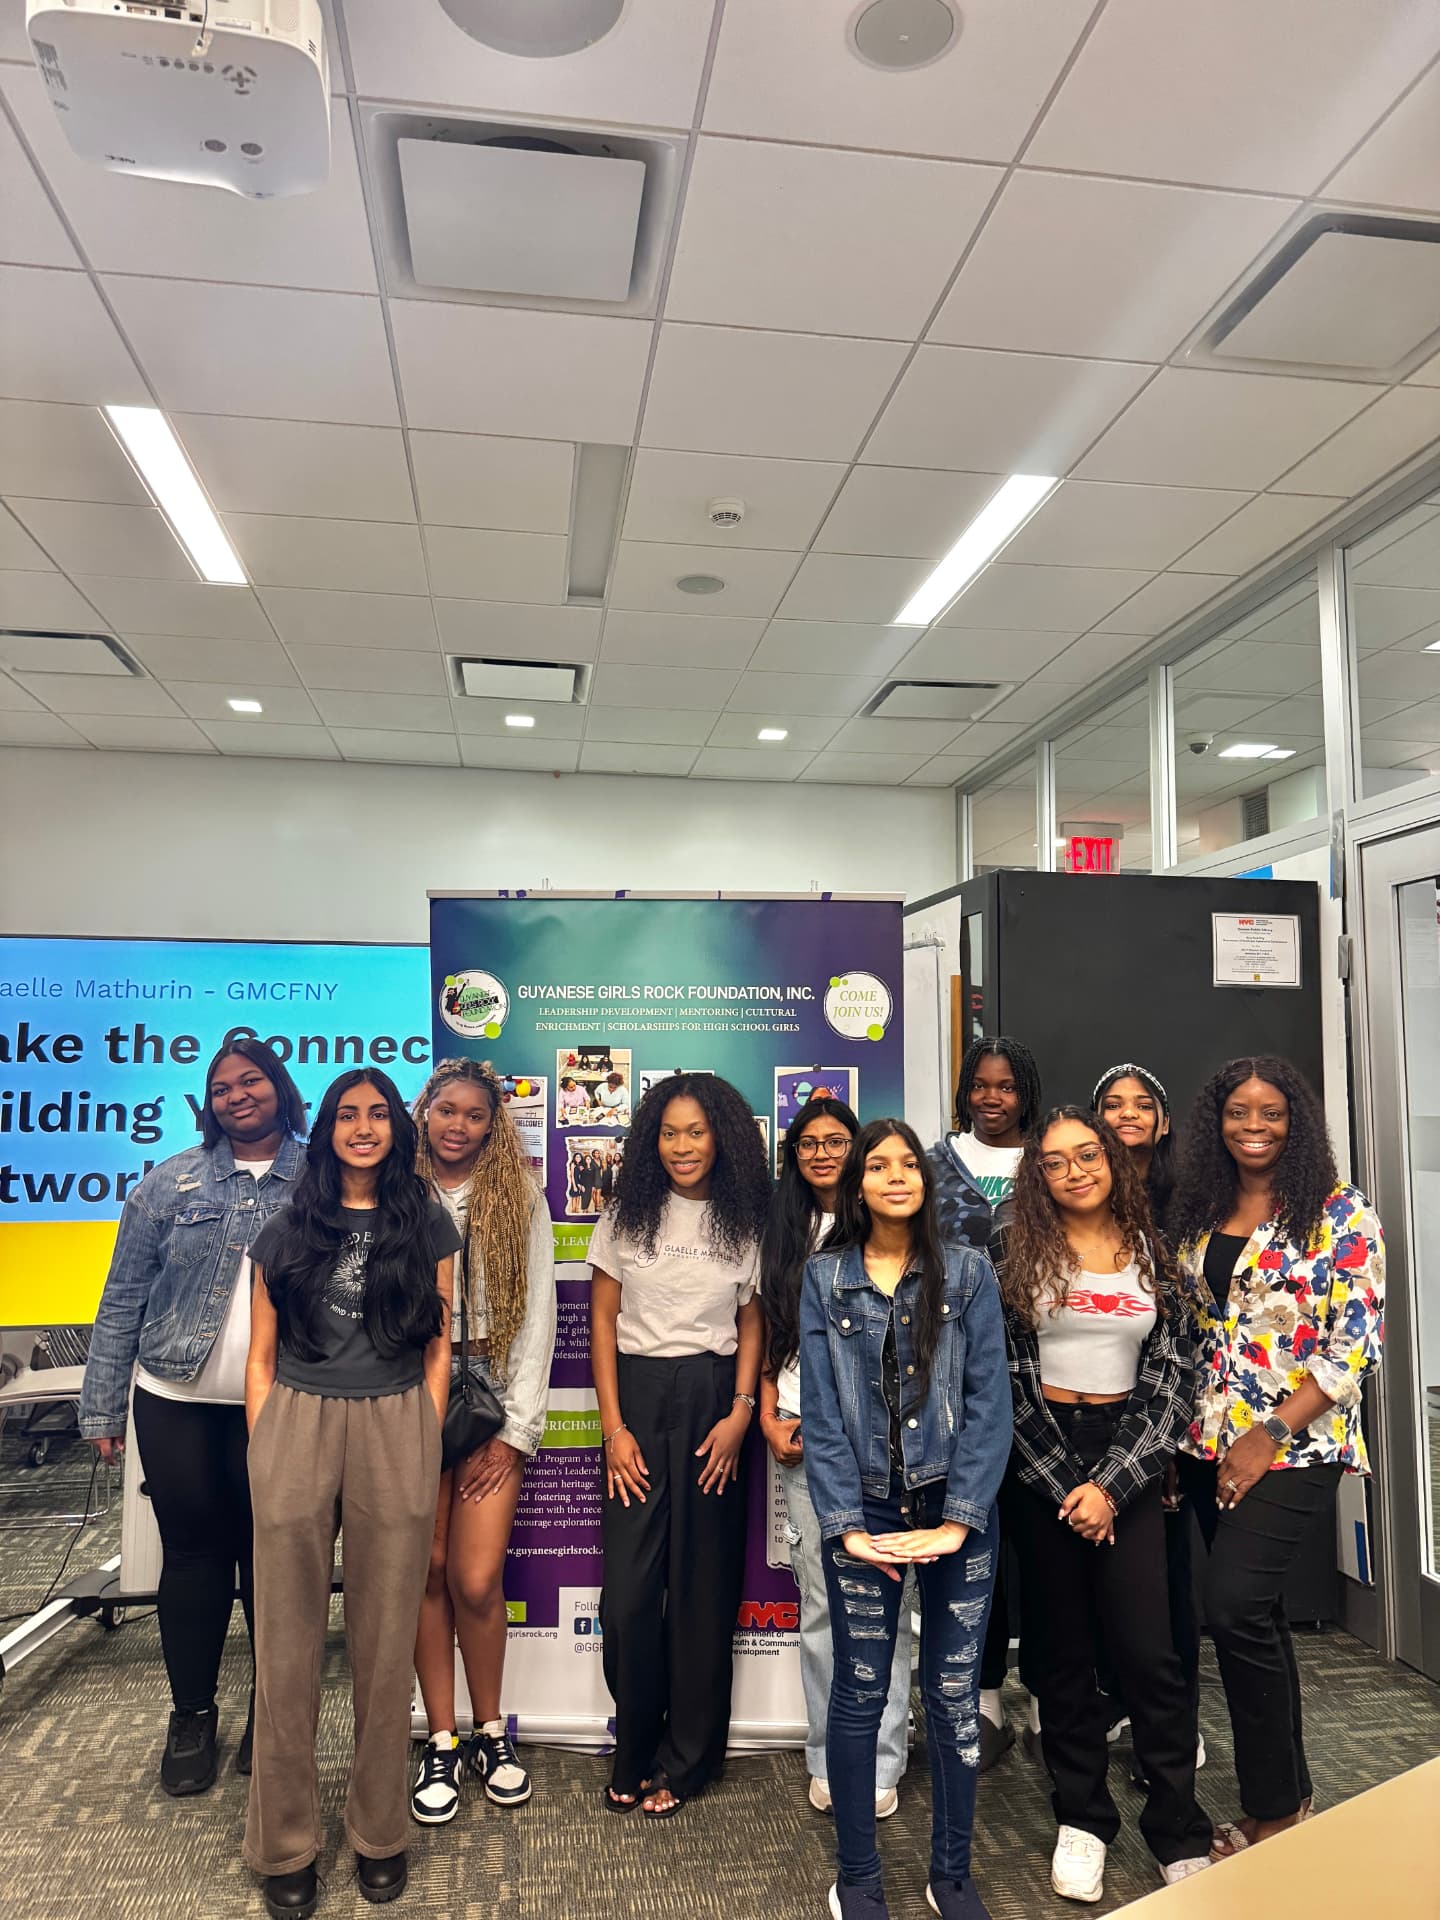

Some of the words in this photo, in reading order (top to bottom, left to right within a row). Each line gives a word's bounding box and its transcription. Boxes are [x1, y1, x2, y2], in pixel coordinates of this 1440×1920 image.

[1071, 837, 1113, 871] EXIT
[75, 979, 192, 999] Mathurin
[227, 982, 338, 1001] GMCFNY
[518, 985, 595, 999] GUYANESE
[598, 985, 641, 999] GIRLS
[644, 986, 685, 999] ROCK
[688, 986, 784, 1001] FOUNDATION,
[786, 986, 816, 1000] INC.
[840, 991, 878, 1001] COME
[539, 1008, 598, 1016] LEADERSHIP
[601, 1008, 674, 1017] DEVELOPMENT
[680, 1008, 739, 1017] MENTORING
[745, 1009, 797, 1017] CULTURAL
[833, 1007, 861, 1018] JOIN
[864, 1007, 884, 1018] US!
[536, 1023, 600, 1031] ENRICHMENT
[608, 1023, 680, 1031] SCHOLARSHIPS
[682, 1023, 701, 1031] FOR
[703, 1023, 729, 1031] HIGH
[731, 1023, 770, 1032] SCHOOL
[772, 1024, 800, 1032] GIRLS
[104, 1023, 201, 1064] the
[976, 1176, 1014, 1197] NIKE
[664, 1244, 698, 1256] GLAELLE
[571, 1325, 591, 1337] girls
[545, 1454, 581, 1465] Program
[584, 1454, 592, 1463] is
[524, 1466, 563, 1476] Women's
[561, 1479, 597, 1491] heritage.
[534, 1492, 571, 1503] fostering
[575, 1493, 603, 1501] aware
[546, 1505, 565, 1514] with
[567, 1505, 581, 1514] the
[512, 1520, 552, 1528] ncourage
[554, 1518, 601, 1529] exploration
[738, 1601, 799, 1628] NYC
[507, 1630, 558, 1640] girlsrock.org
[751, 1639, 757, 1647] &
